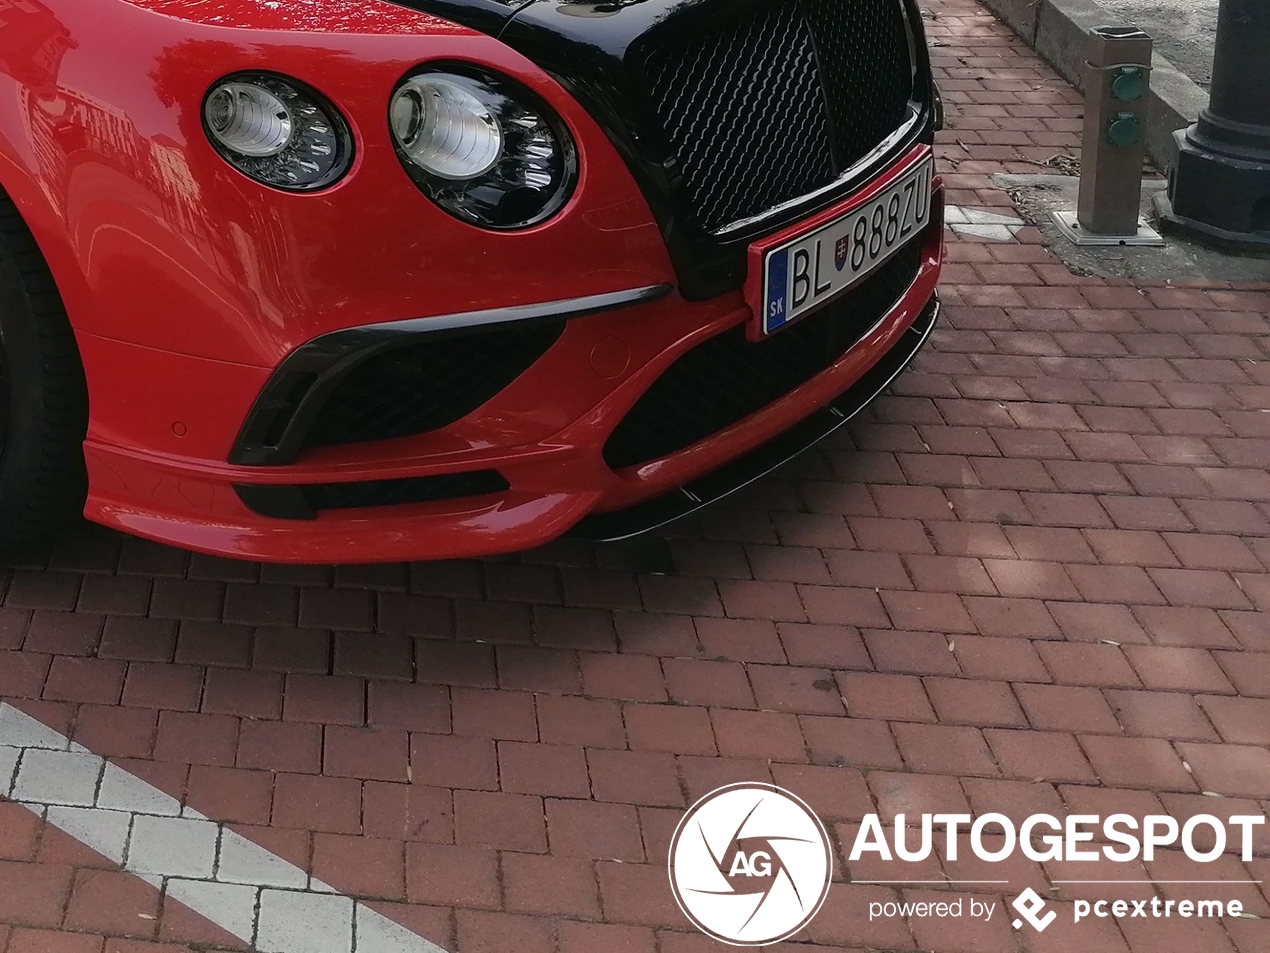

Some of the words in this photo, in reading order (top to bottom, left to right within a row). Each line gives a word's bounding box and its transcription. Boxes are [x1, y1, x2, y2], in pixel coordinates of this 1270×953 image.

[791, 239, 832, 310] BL
[850, 165, 930, 273] 888ZU
[770, 297, 784, 317] SK
